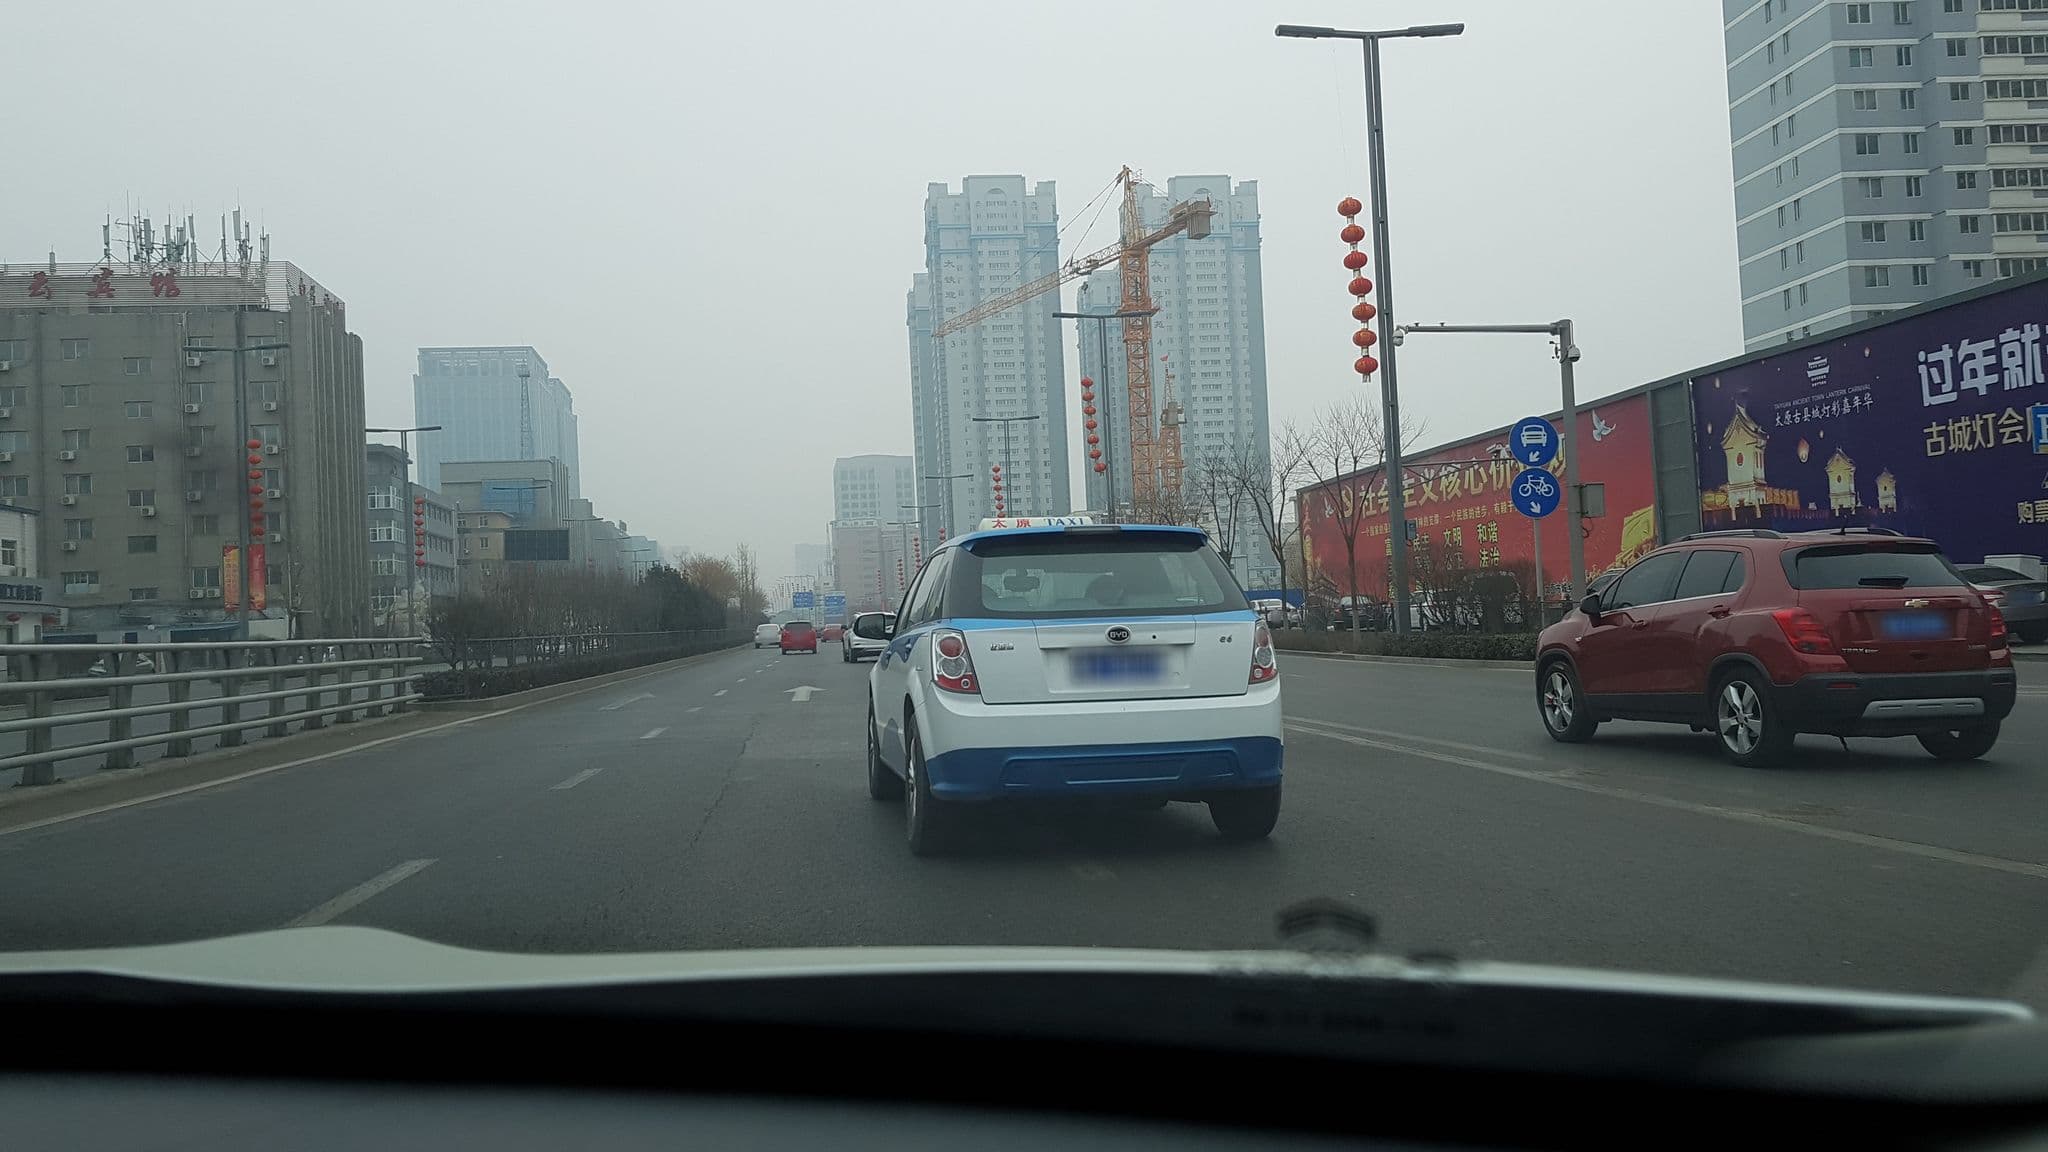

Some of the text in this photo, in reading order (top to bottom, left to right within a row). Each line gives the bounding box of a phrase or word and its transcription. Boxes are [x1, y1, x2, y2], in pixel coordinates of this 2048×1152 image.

[1918, 322, 2048, 407] 过年就
[1923, 402, 2033, 457] 古城灯会
[1359, 433, 1567, 519] 社会主义核心价
[992, 518, 1031, 528] 太原
[1044, 517, 1085, 527] TAXI
[1443, 526, 1463, 547] 文明
[1477, 520, 1499, 544] 和谐
[1479, 546, 1500, 568] 法治
[1109, 630, 1129, 639] BYD
[1219, 634, 1233, 644] e6
